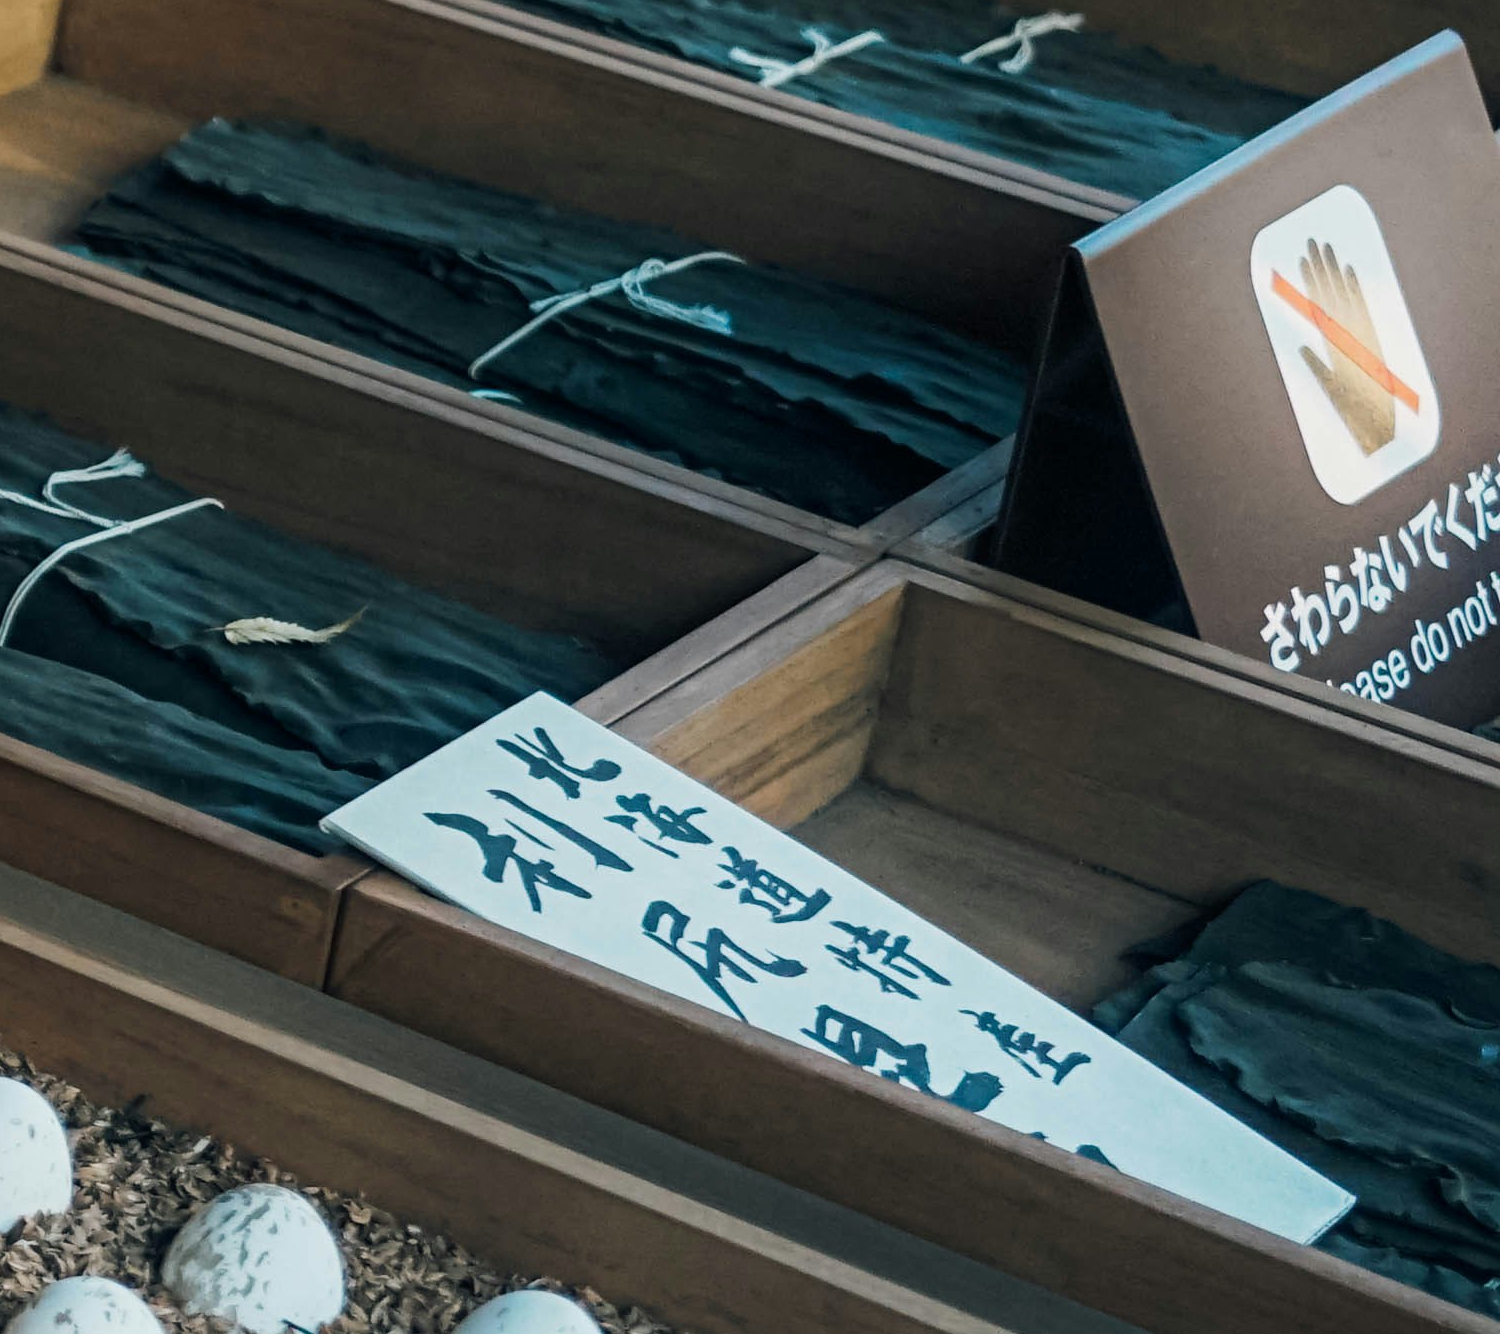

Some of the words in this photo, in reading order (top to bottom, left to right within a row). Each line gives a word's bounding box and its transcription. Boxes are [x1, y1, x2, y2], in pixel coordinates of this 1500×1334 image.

[1260, 453, 1500, 672] さわらないでくだ
[1410, 618, 1450, 674] do
[1447, 580, 1498, 649] not
[425, 789, 1118, 1172] 利尻昆
[496, 726, 1090, 1085] 北海道特産
